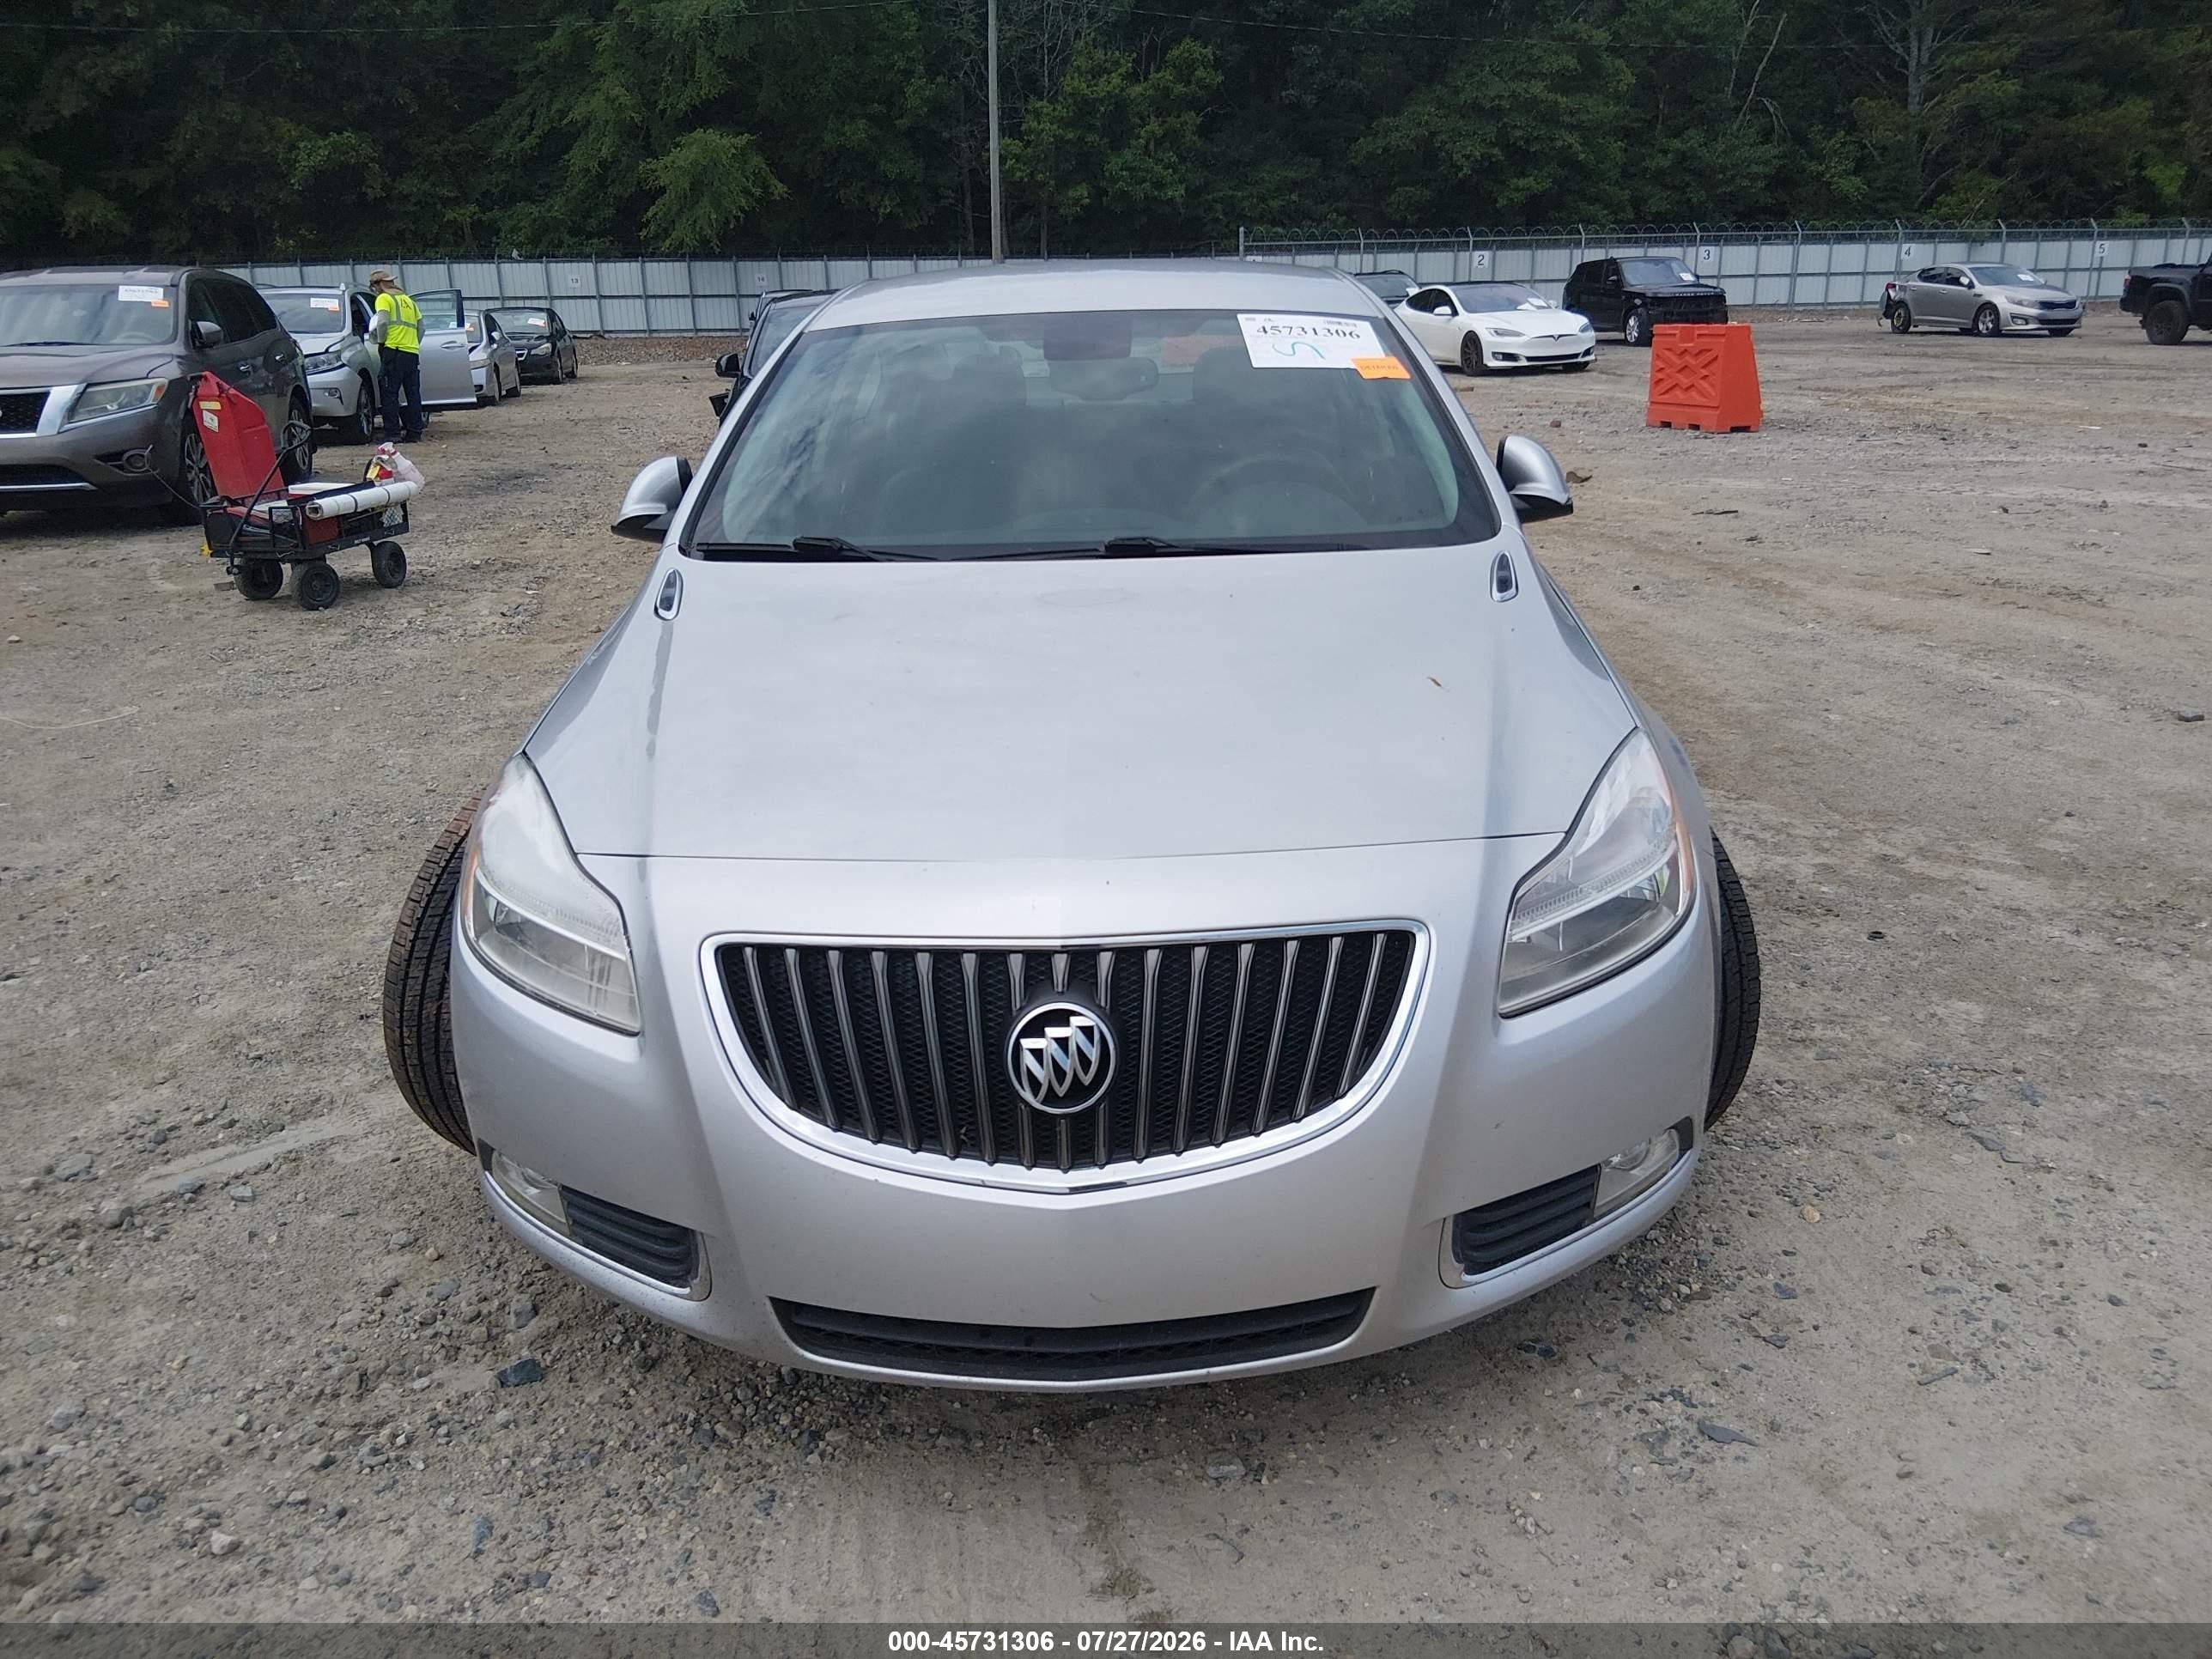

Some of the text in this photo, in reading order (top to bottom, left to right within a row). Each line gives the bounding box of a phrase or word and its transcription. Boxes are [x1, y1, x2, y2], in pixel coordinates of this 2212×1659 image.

[1904, 246, 1911, 258] 4
[2099, 243, 2106, 254] 5
[1477, 254, 1485, 266] 2
[1703, 249, 1711, 261] 3
[1256, 325, 1361, 338] 45731306
